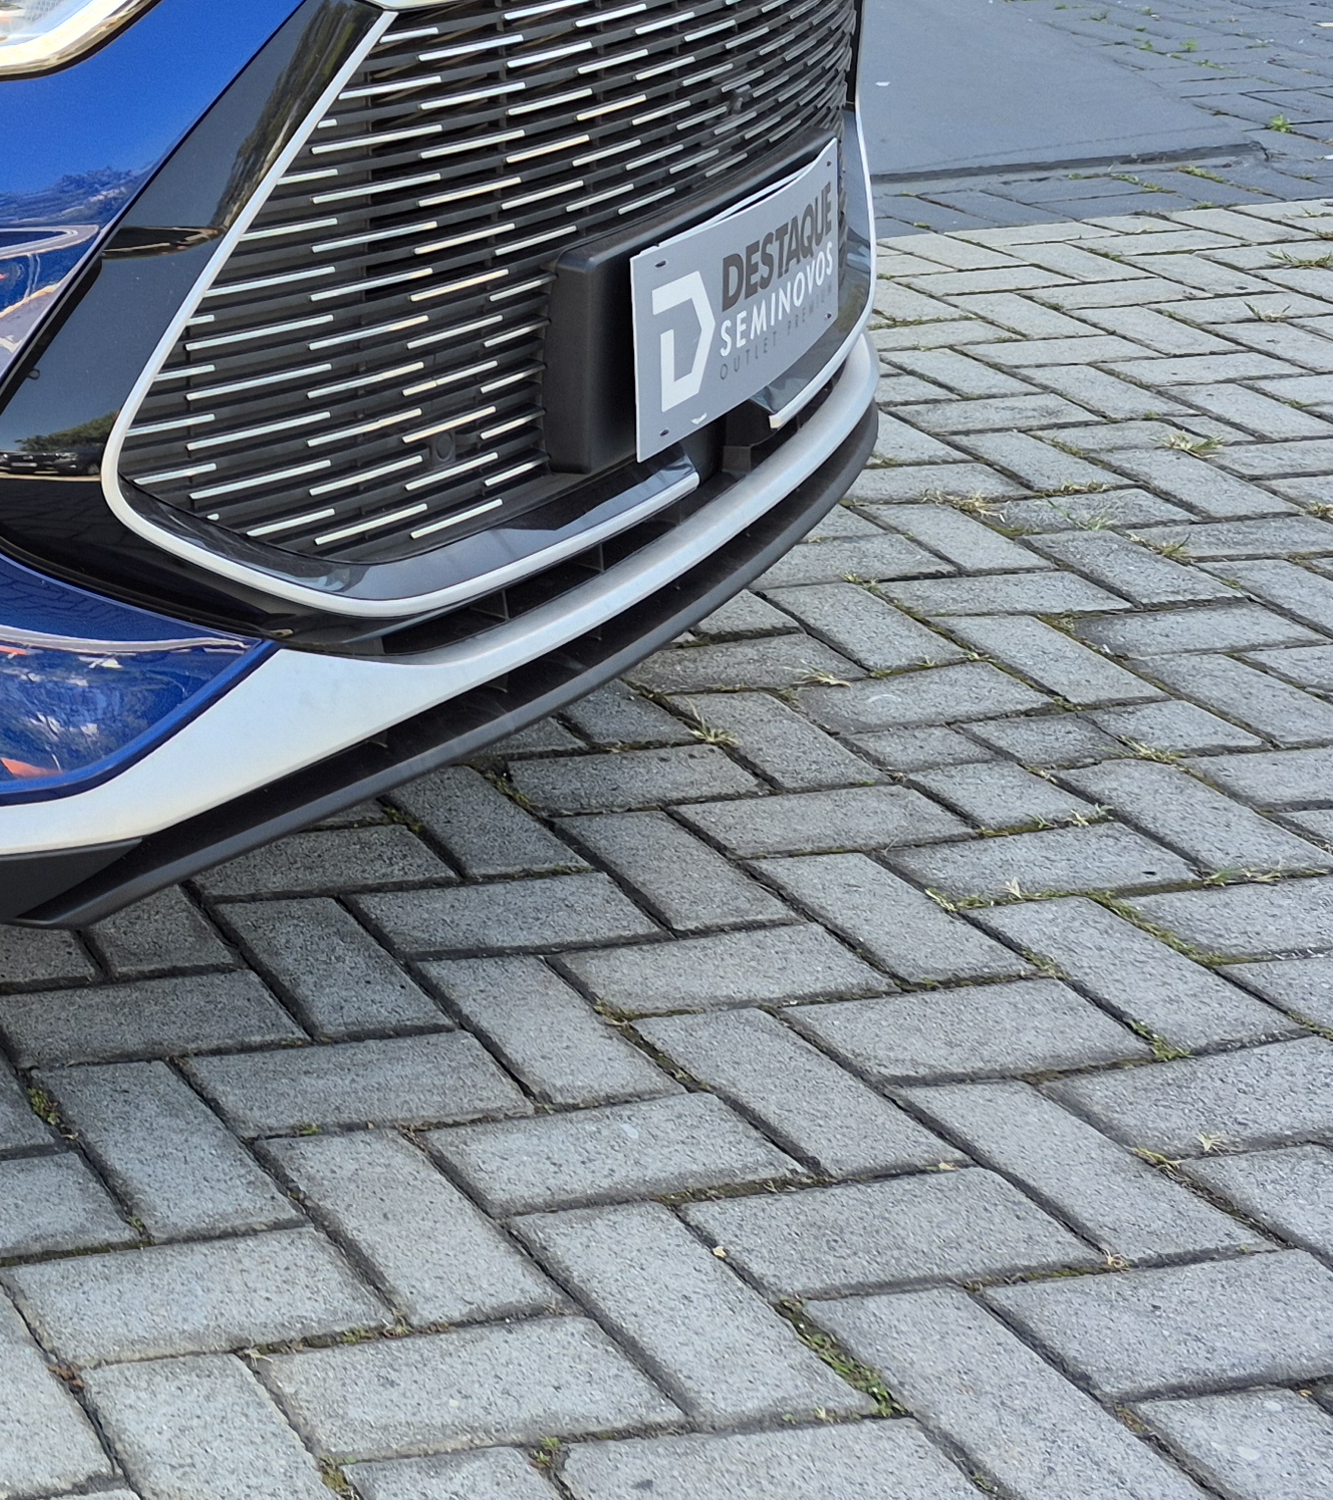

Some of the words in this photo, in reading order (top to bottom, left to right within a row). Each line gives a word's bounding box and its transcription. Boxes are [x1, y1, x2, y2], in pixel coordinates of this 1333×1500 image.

[720, 241, 833, 357] SEMINOVOS
[721, 181, 832, 313] DESTAQUE
[719, 331, 777, 380] OUTLET
